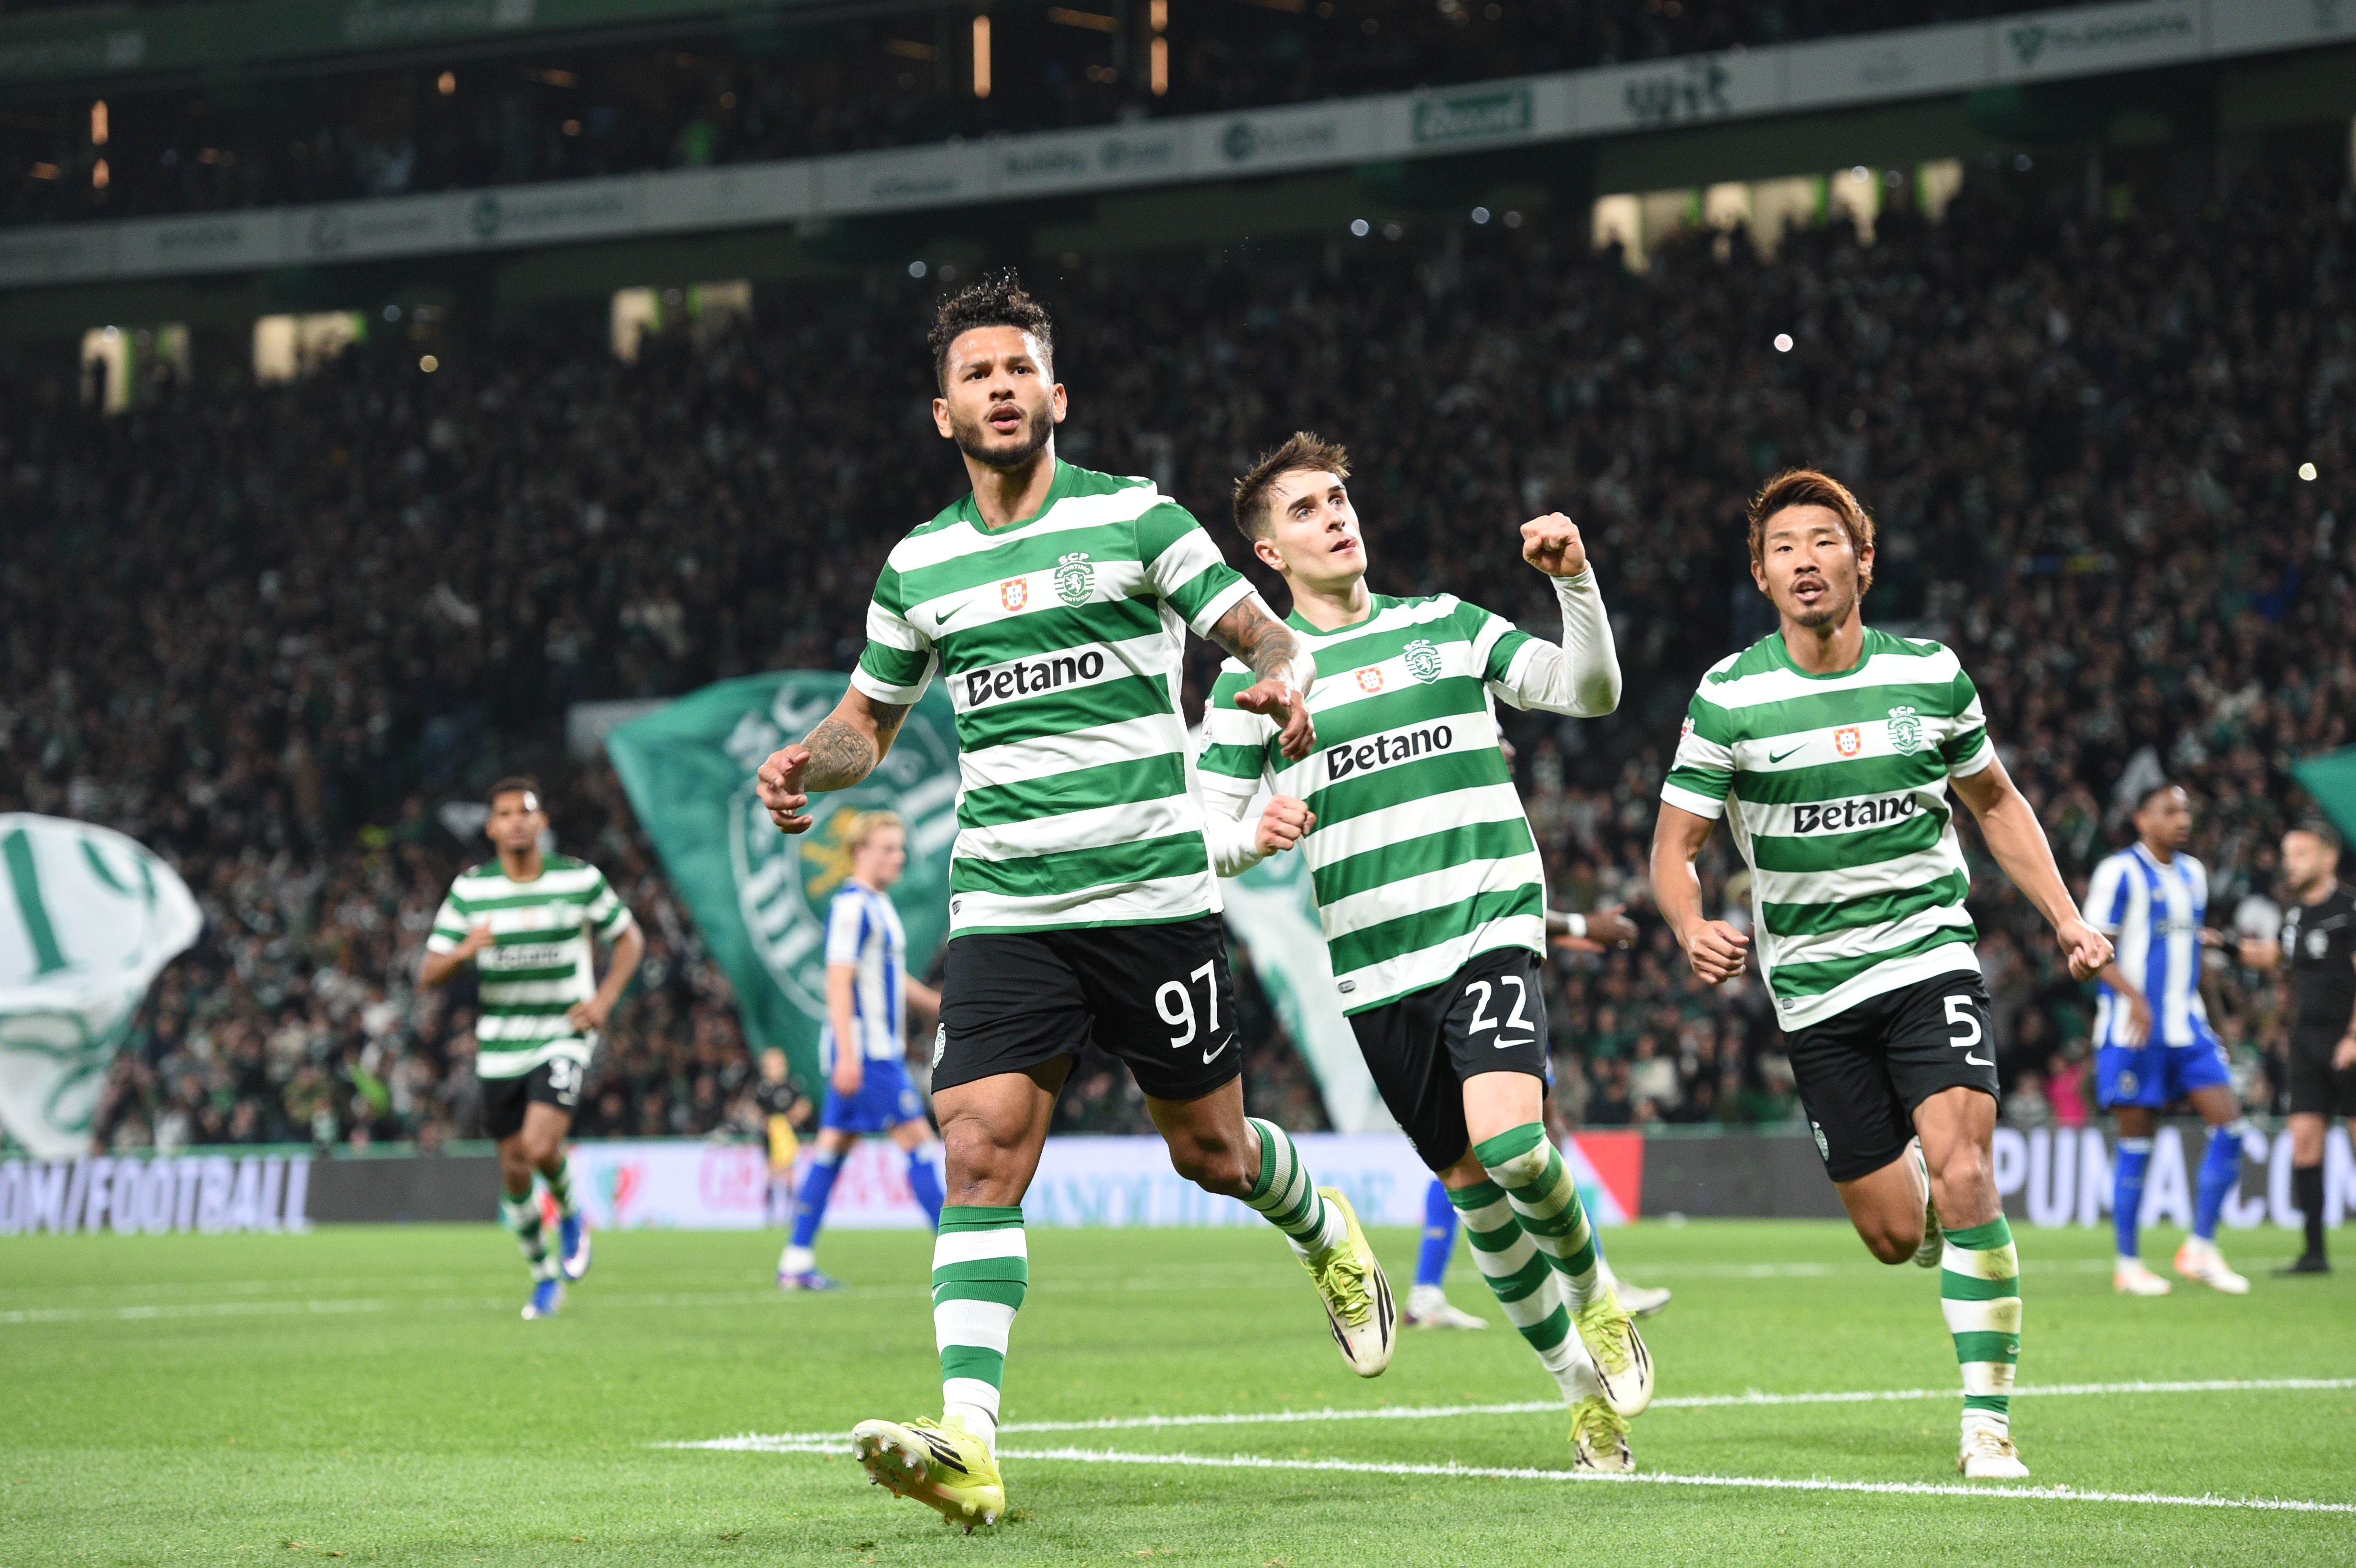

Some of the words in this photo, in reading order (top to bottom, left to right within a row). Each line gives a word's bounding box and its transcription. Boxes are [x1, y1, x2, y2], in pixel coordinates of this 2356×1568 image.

[1058, 552, 1089, 566] SCP
[1060, 592, 1091, 601] PORTUGAL
[1403, 639, 1430, 652] SCP
[966, 651, 1104, 707] Betano
[1888, 706, 1916, 718] SCP
[1326, 725, 1453, 781] Betano
[1793, 793, 1917, 833] Betano
[1155, 958, 1220, 1048] 97
[1465, 975, 1535, 1035] 22
[1943, 994, 1982, 1047] 5
